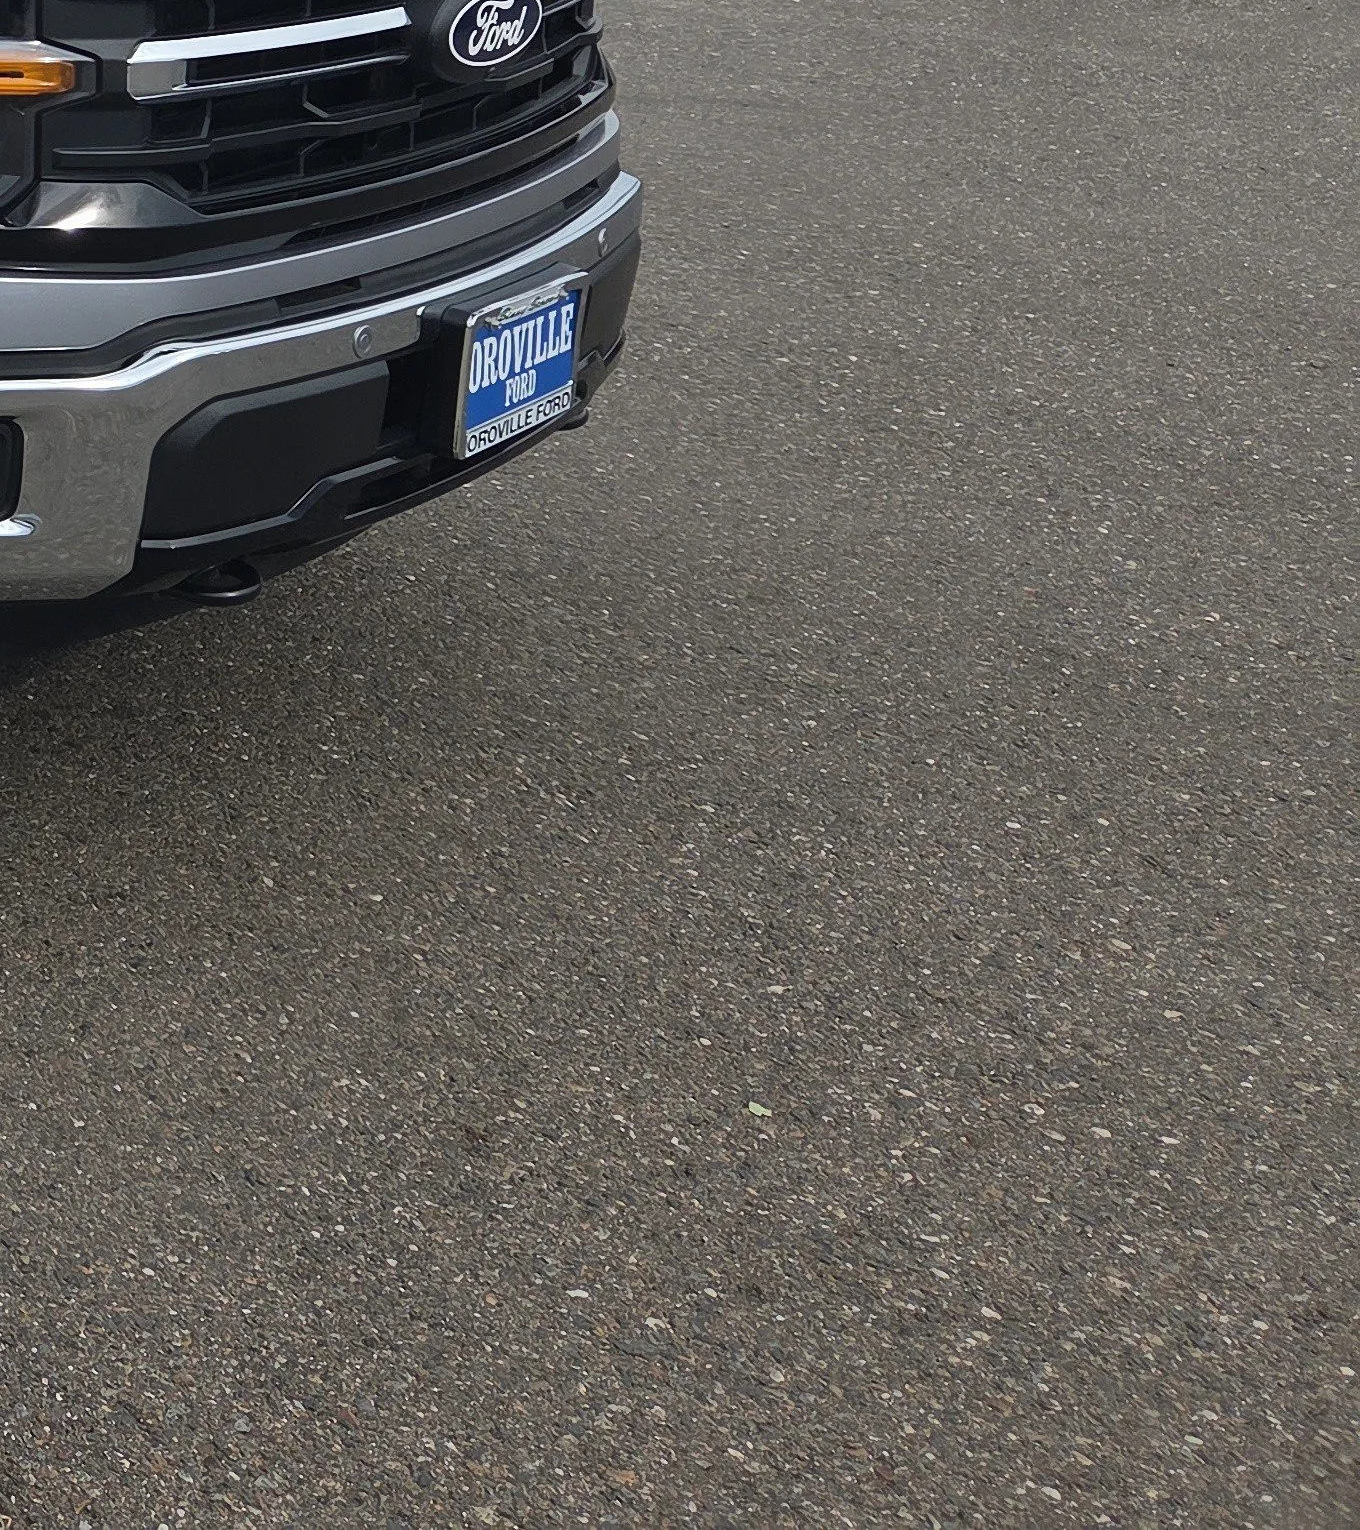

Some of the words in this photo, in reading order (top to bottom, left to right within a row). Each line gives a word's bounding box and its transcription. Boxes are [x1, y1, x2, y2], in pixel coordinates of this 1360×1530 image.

[468, 303, 575, 394] OROVILLE
[504, 369, 537, 408] FORD
[467, 408, 534, 453] OROVILLE
[535, 391, 571, 421] FORD
